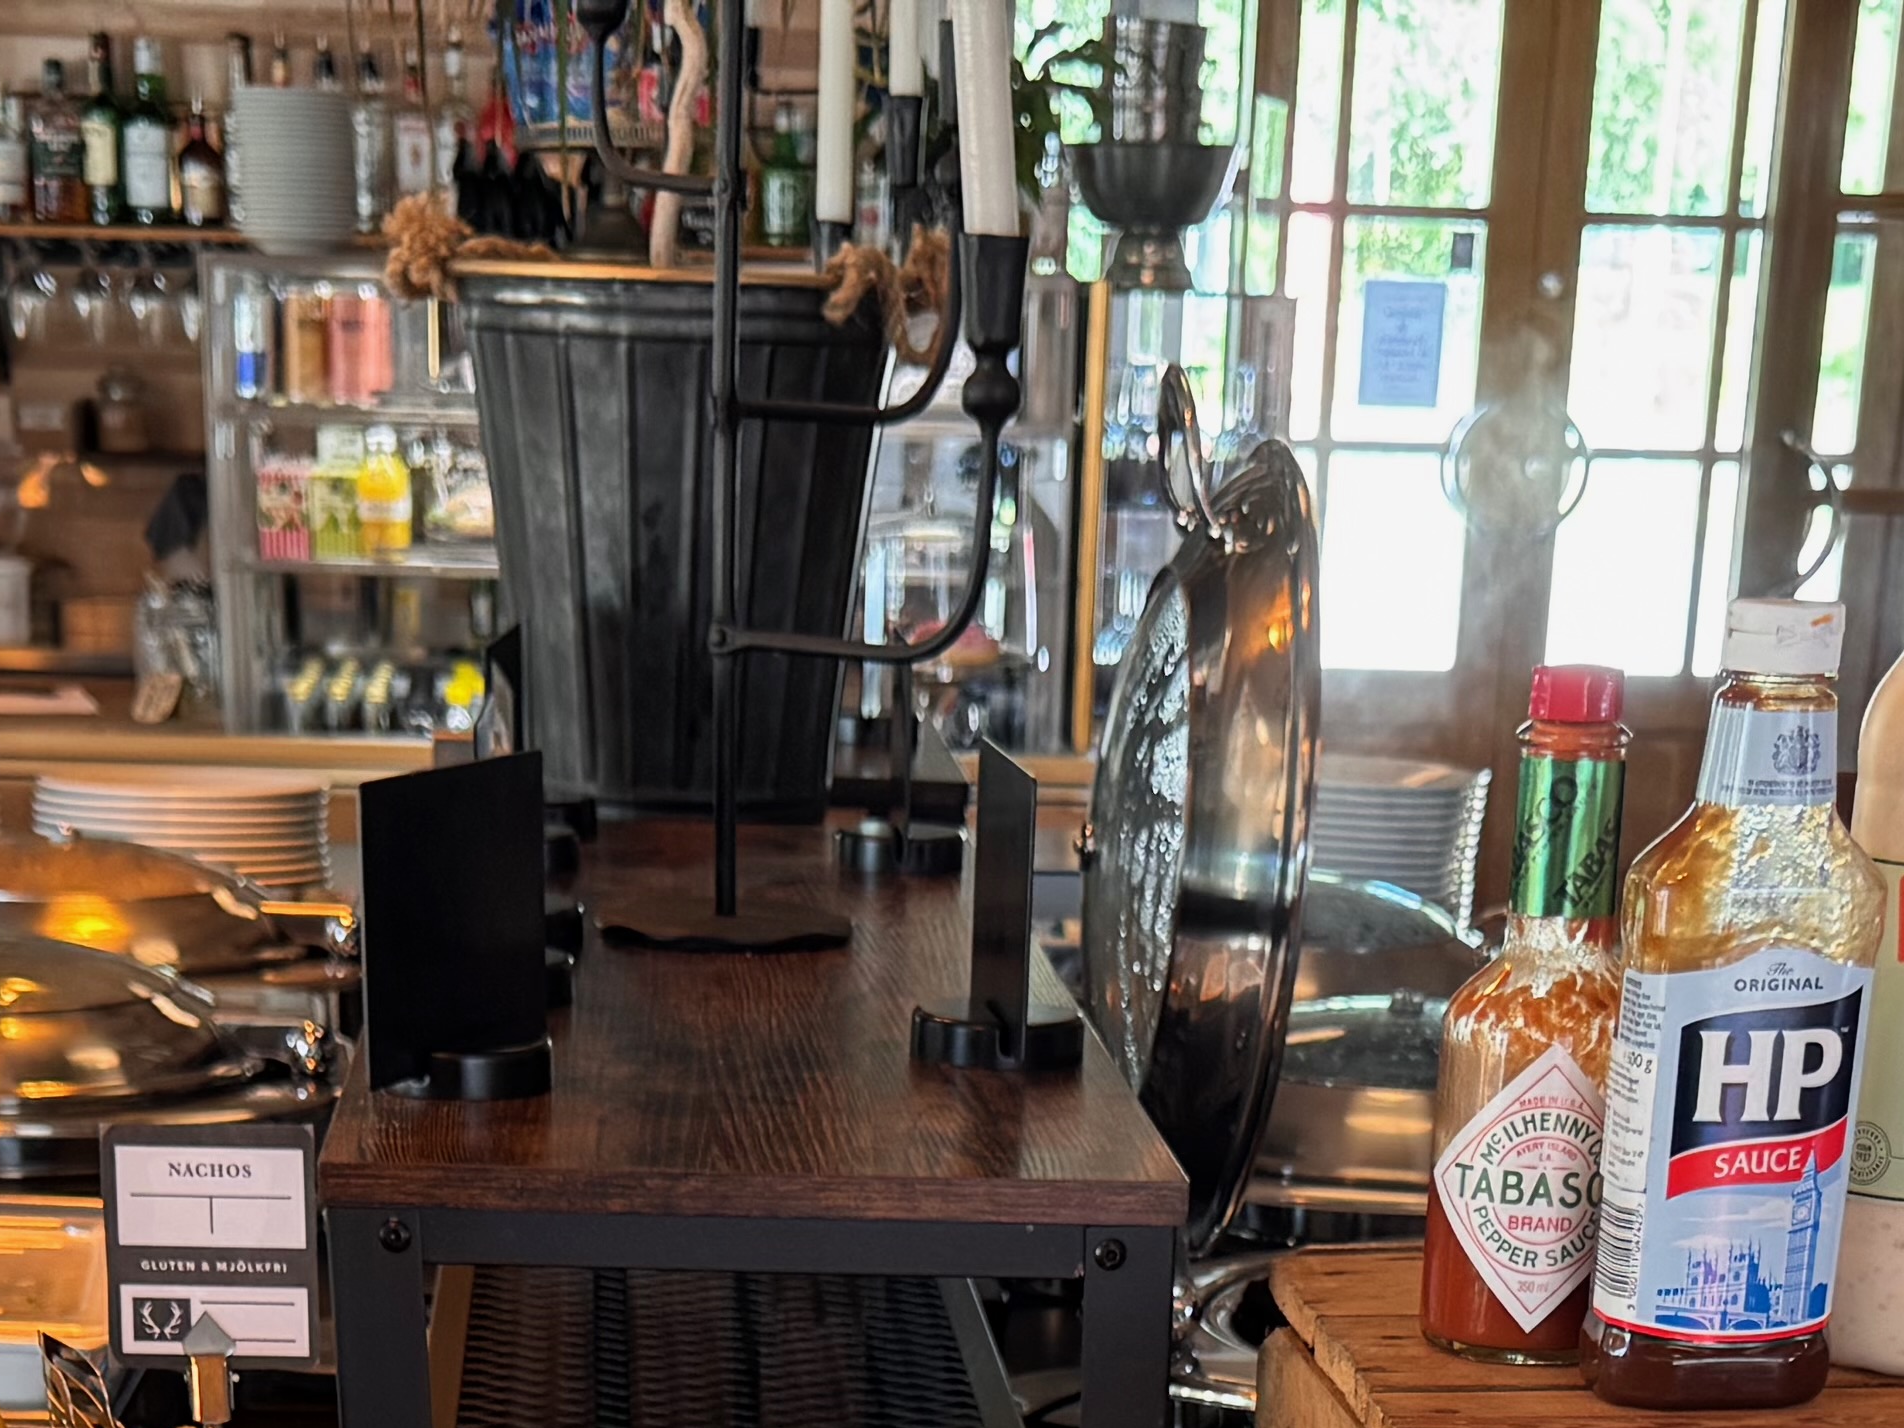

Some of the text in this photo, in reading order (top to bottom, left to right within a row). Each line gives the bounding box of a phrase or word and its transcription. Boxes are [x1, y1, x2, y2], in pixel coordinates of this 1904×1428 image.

[1767, 963, 1793, 978] The
[1733, 977, 1824, 993] ORIGINAL
[1693, 1028, 1844, 1123] HP
[1516, 1142, 1545, 1158] AVERY
[168, 1162, 252, 1178] NACHOS
[1714, 1145, 1802, 1179] SAUCE
[1455, 1162, 1603, 1209] TABASC
[1508, 1215, 1572, 1232] BRAND
[1473, 1206, 1539, 1268] PEPPER
[141, 1260, 195, 1272] GLUTEN
[216, 1260, 287, 1273] MJÖLKFRI
